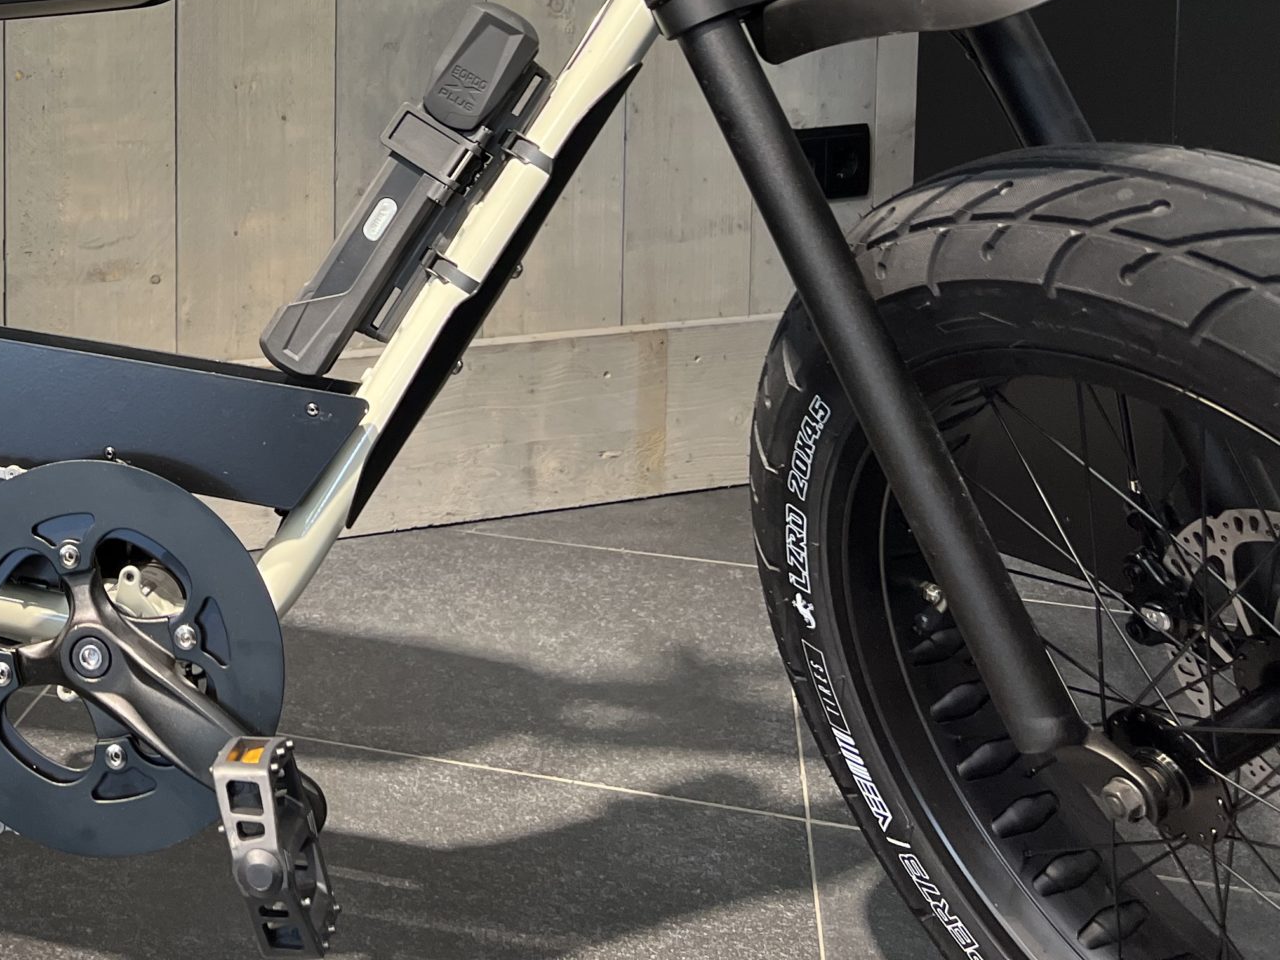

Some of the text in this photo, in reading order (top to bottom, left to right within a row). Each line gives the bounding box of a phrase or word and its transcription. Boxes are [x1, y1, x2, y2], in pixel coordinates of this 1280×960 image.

[437, 87, 475, 111] PLUS
[785, 502, 812, 595] LZRD
[810, 659, 840, 716] TIRES
